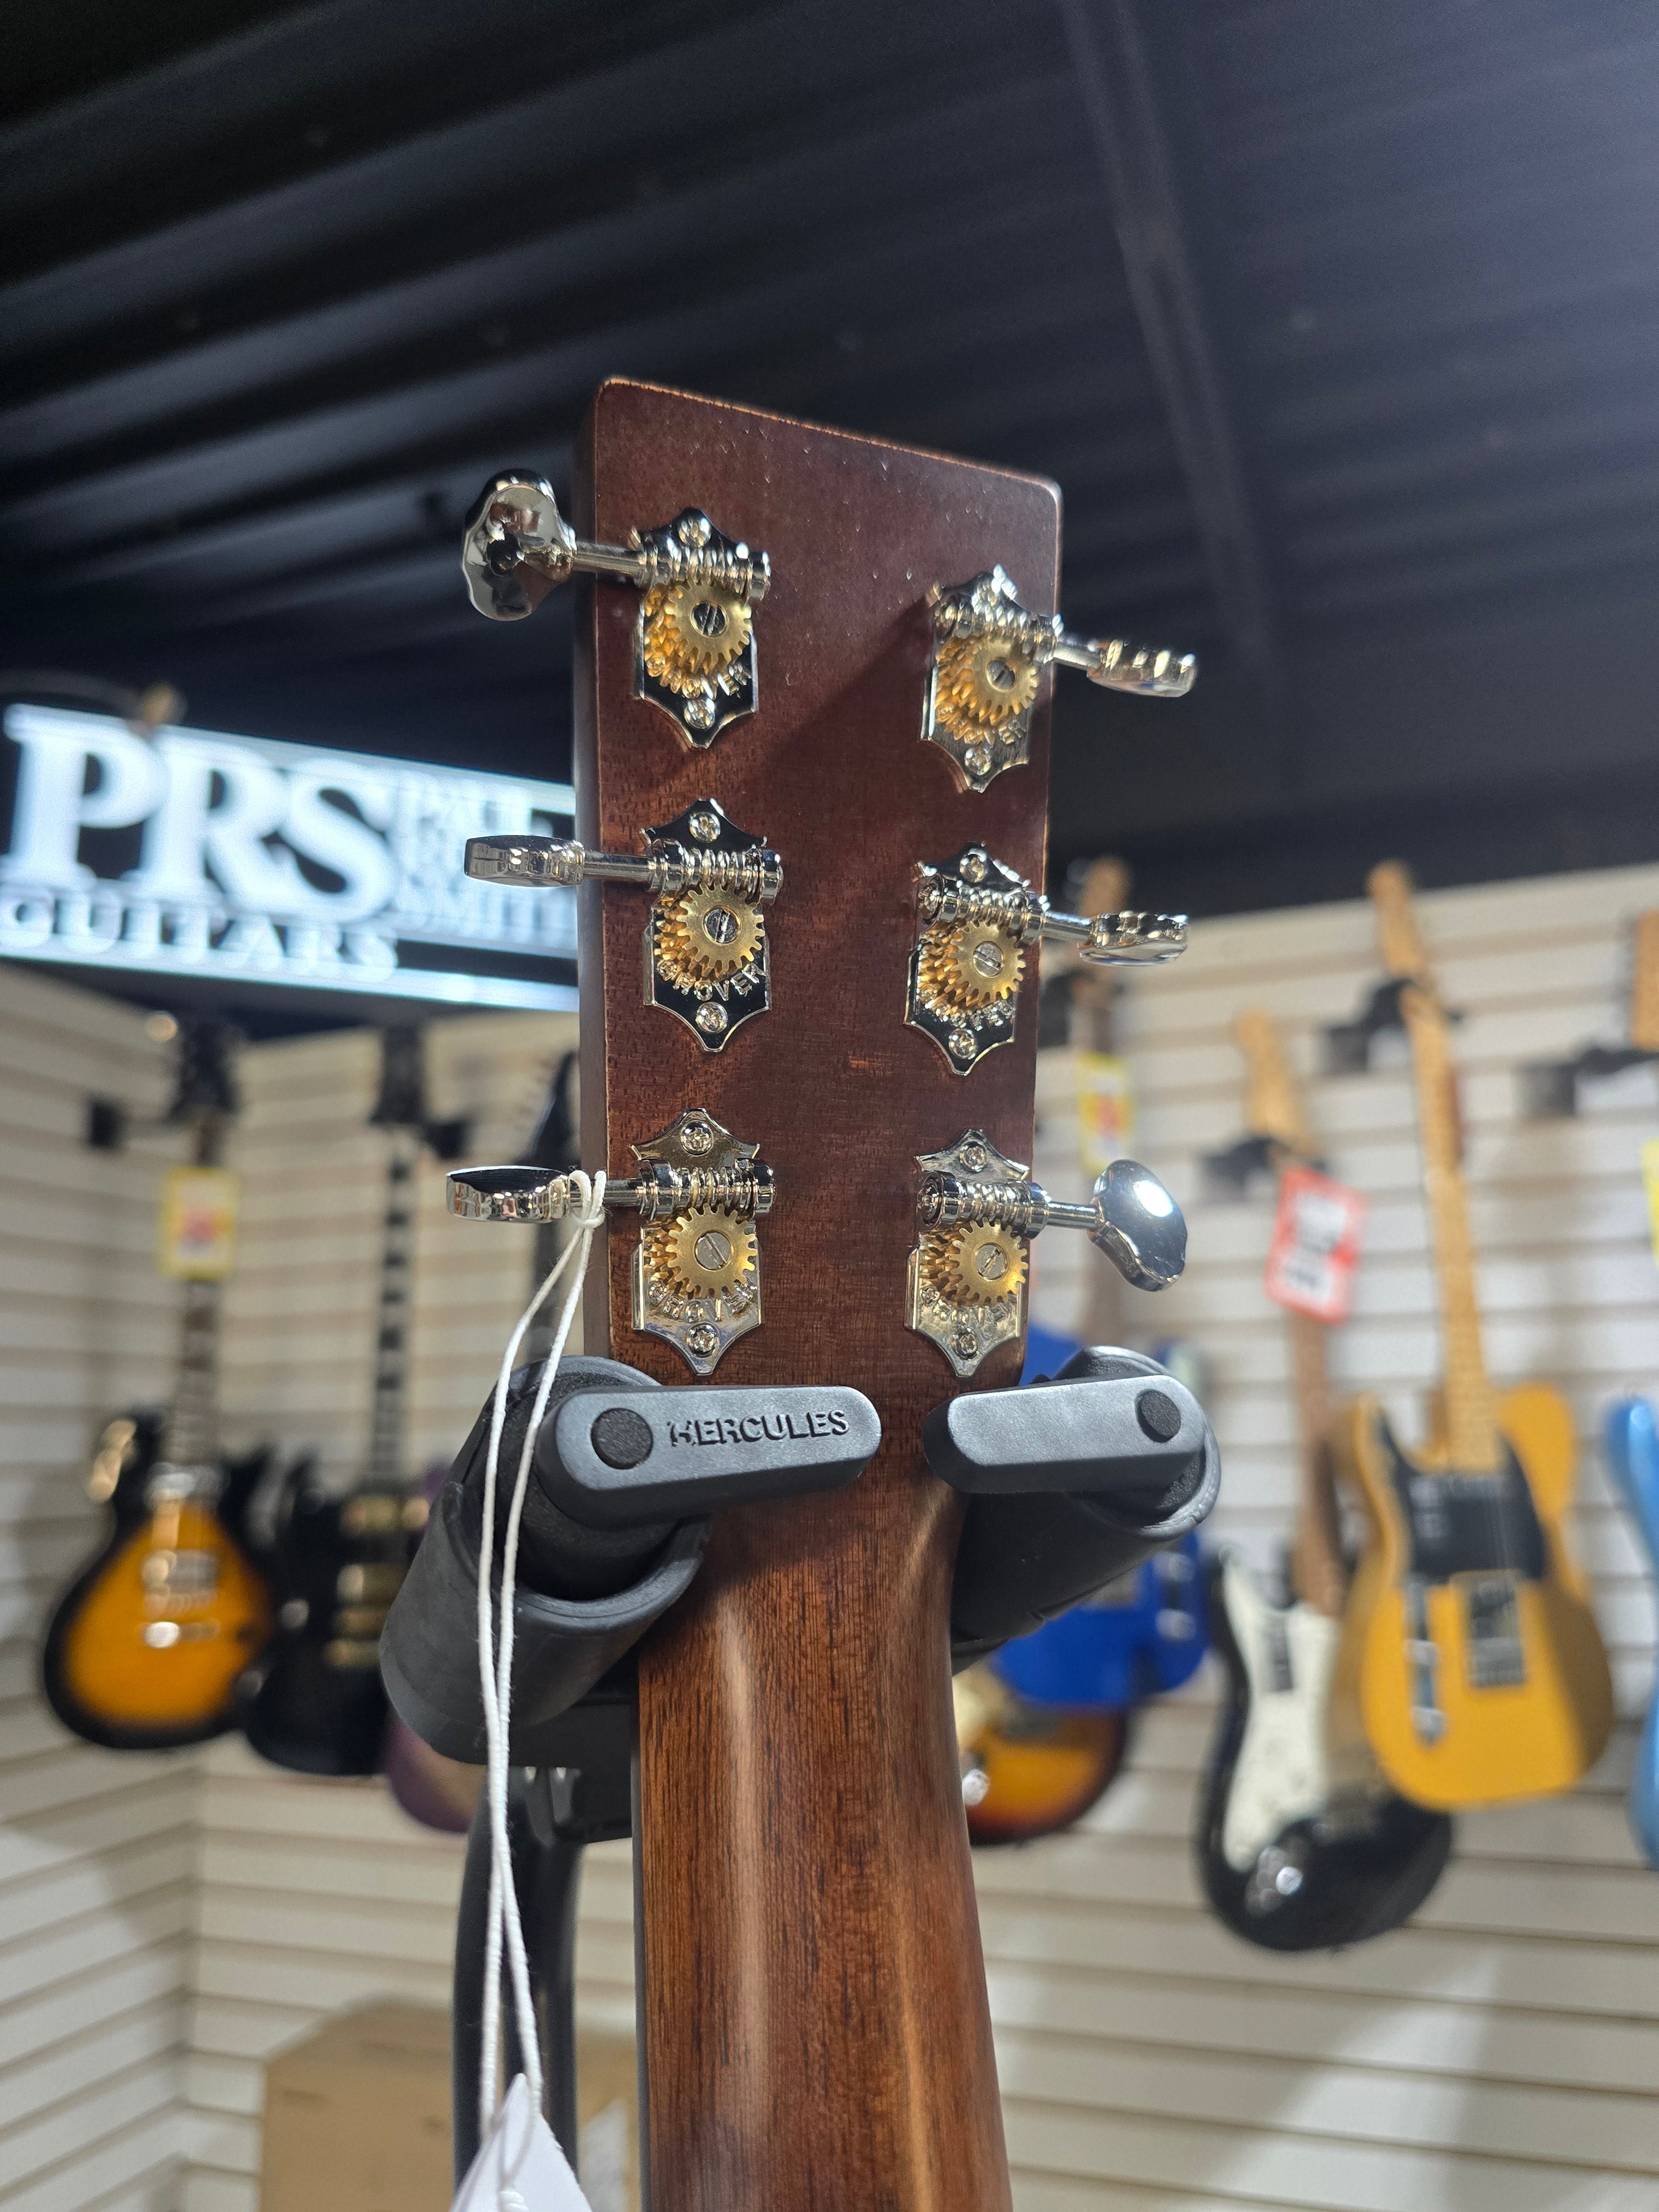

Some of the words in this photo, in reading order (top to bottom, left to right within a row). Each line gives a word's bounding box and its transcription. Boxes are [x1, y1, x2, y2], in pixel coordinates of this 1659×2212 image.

[0, 703, 397, 925] PRS
[656, 958, 766, 1001] GROVER
[666, 1410, 850, 1447] HERCULES
